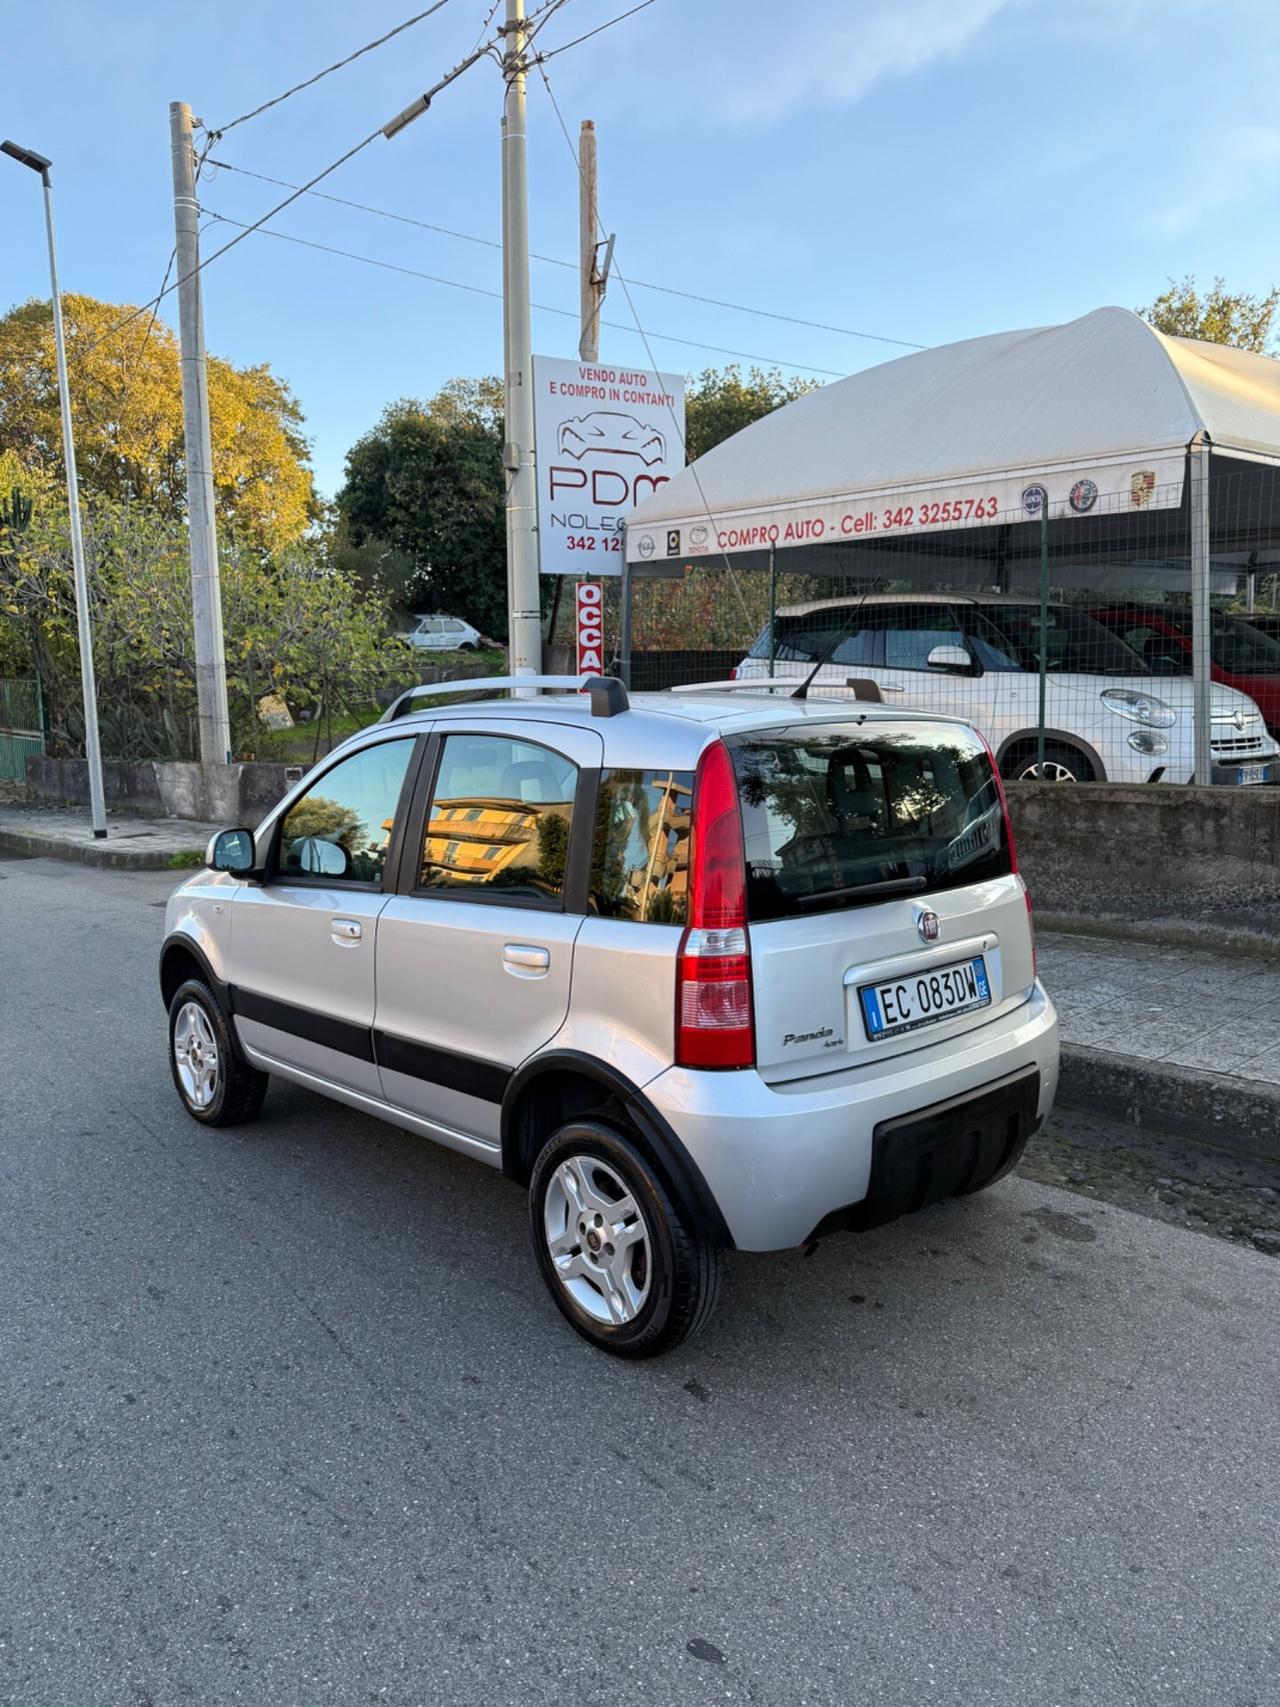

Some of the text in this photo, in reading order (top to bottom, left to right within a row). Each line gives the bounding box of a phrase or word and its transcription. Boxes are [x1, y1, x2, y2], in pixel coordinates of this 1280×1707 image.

[579, 367, 647, 387] VENDO AUTO
[549, 381, 675, 407] E COMPRO IN CONTANTI
[717, 524, 779, 548] COMPRO
[784, 518, 825, 541] AUTO
[841, 511, 877, 534] Cell:
[883, 507, 914, 529] 342
[919, 496, 999, 525] 3255763
[566, 536, 596, 551] 342
[579, 584, 602, 677] OCCA
[880, 985, 911, 1024] EC
[916, 965, 977, 1013] 083DW
[782, 1027, 834, 1047] Panda
